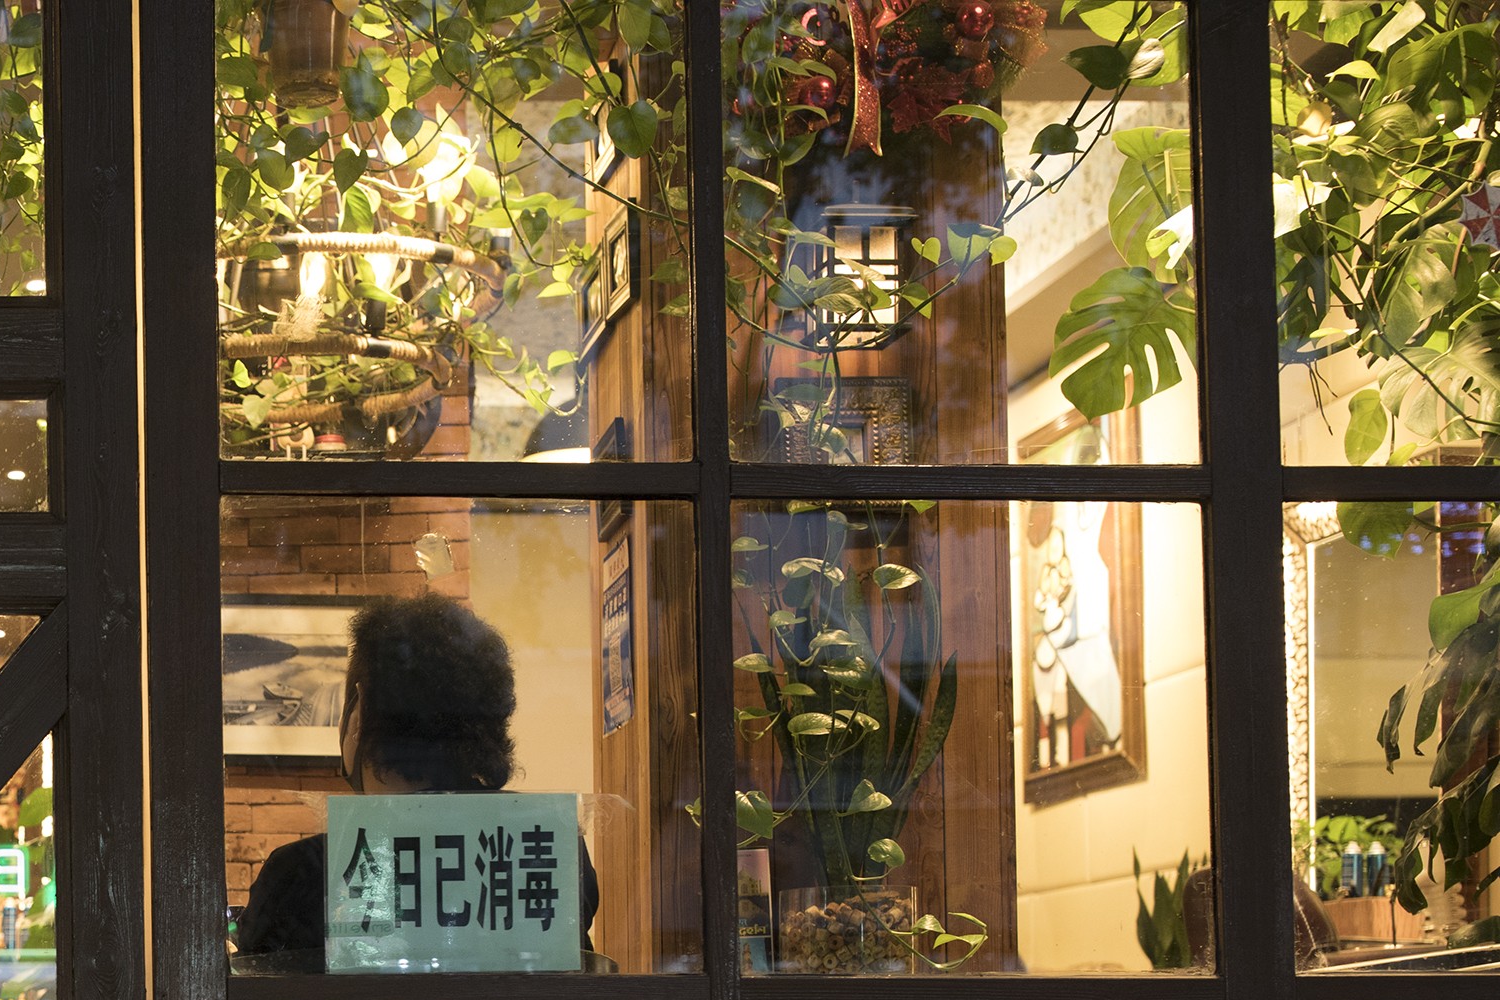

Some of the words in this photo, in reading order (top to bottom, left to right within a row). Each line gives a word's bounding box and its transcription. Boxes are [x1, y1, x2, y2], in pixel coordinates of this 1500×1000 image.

[343, 824, 559, 932] 今日已消毒
